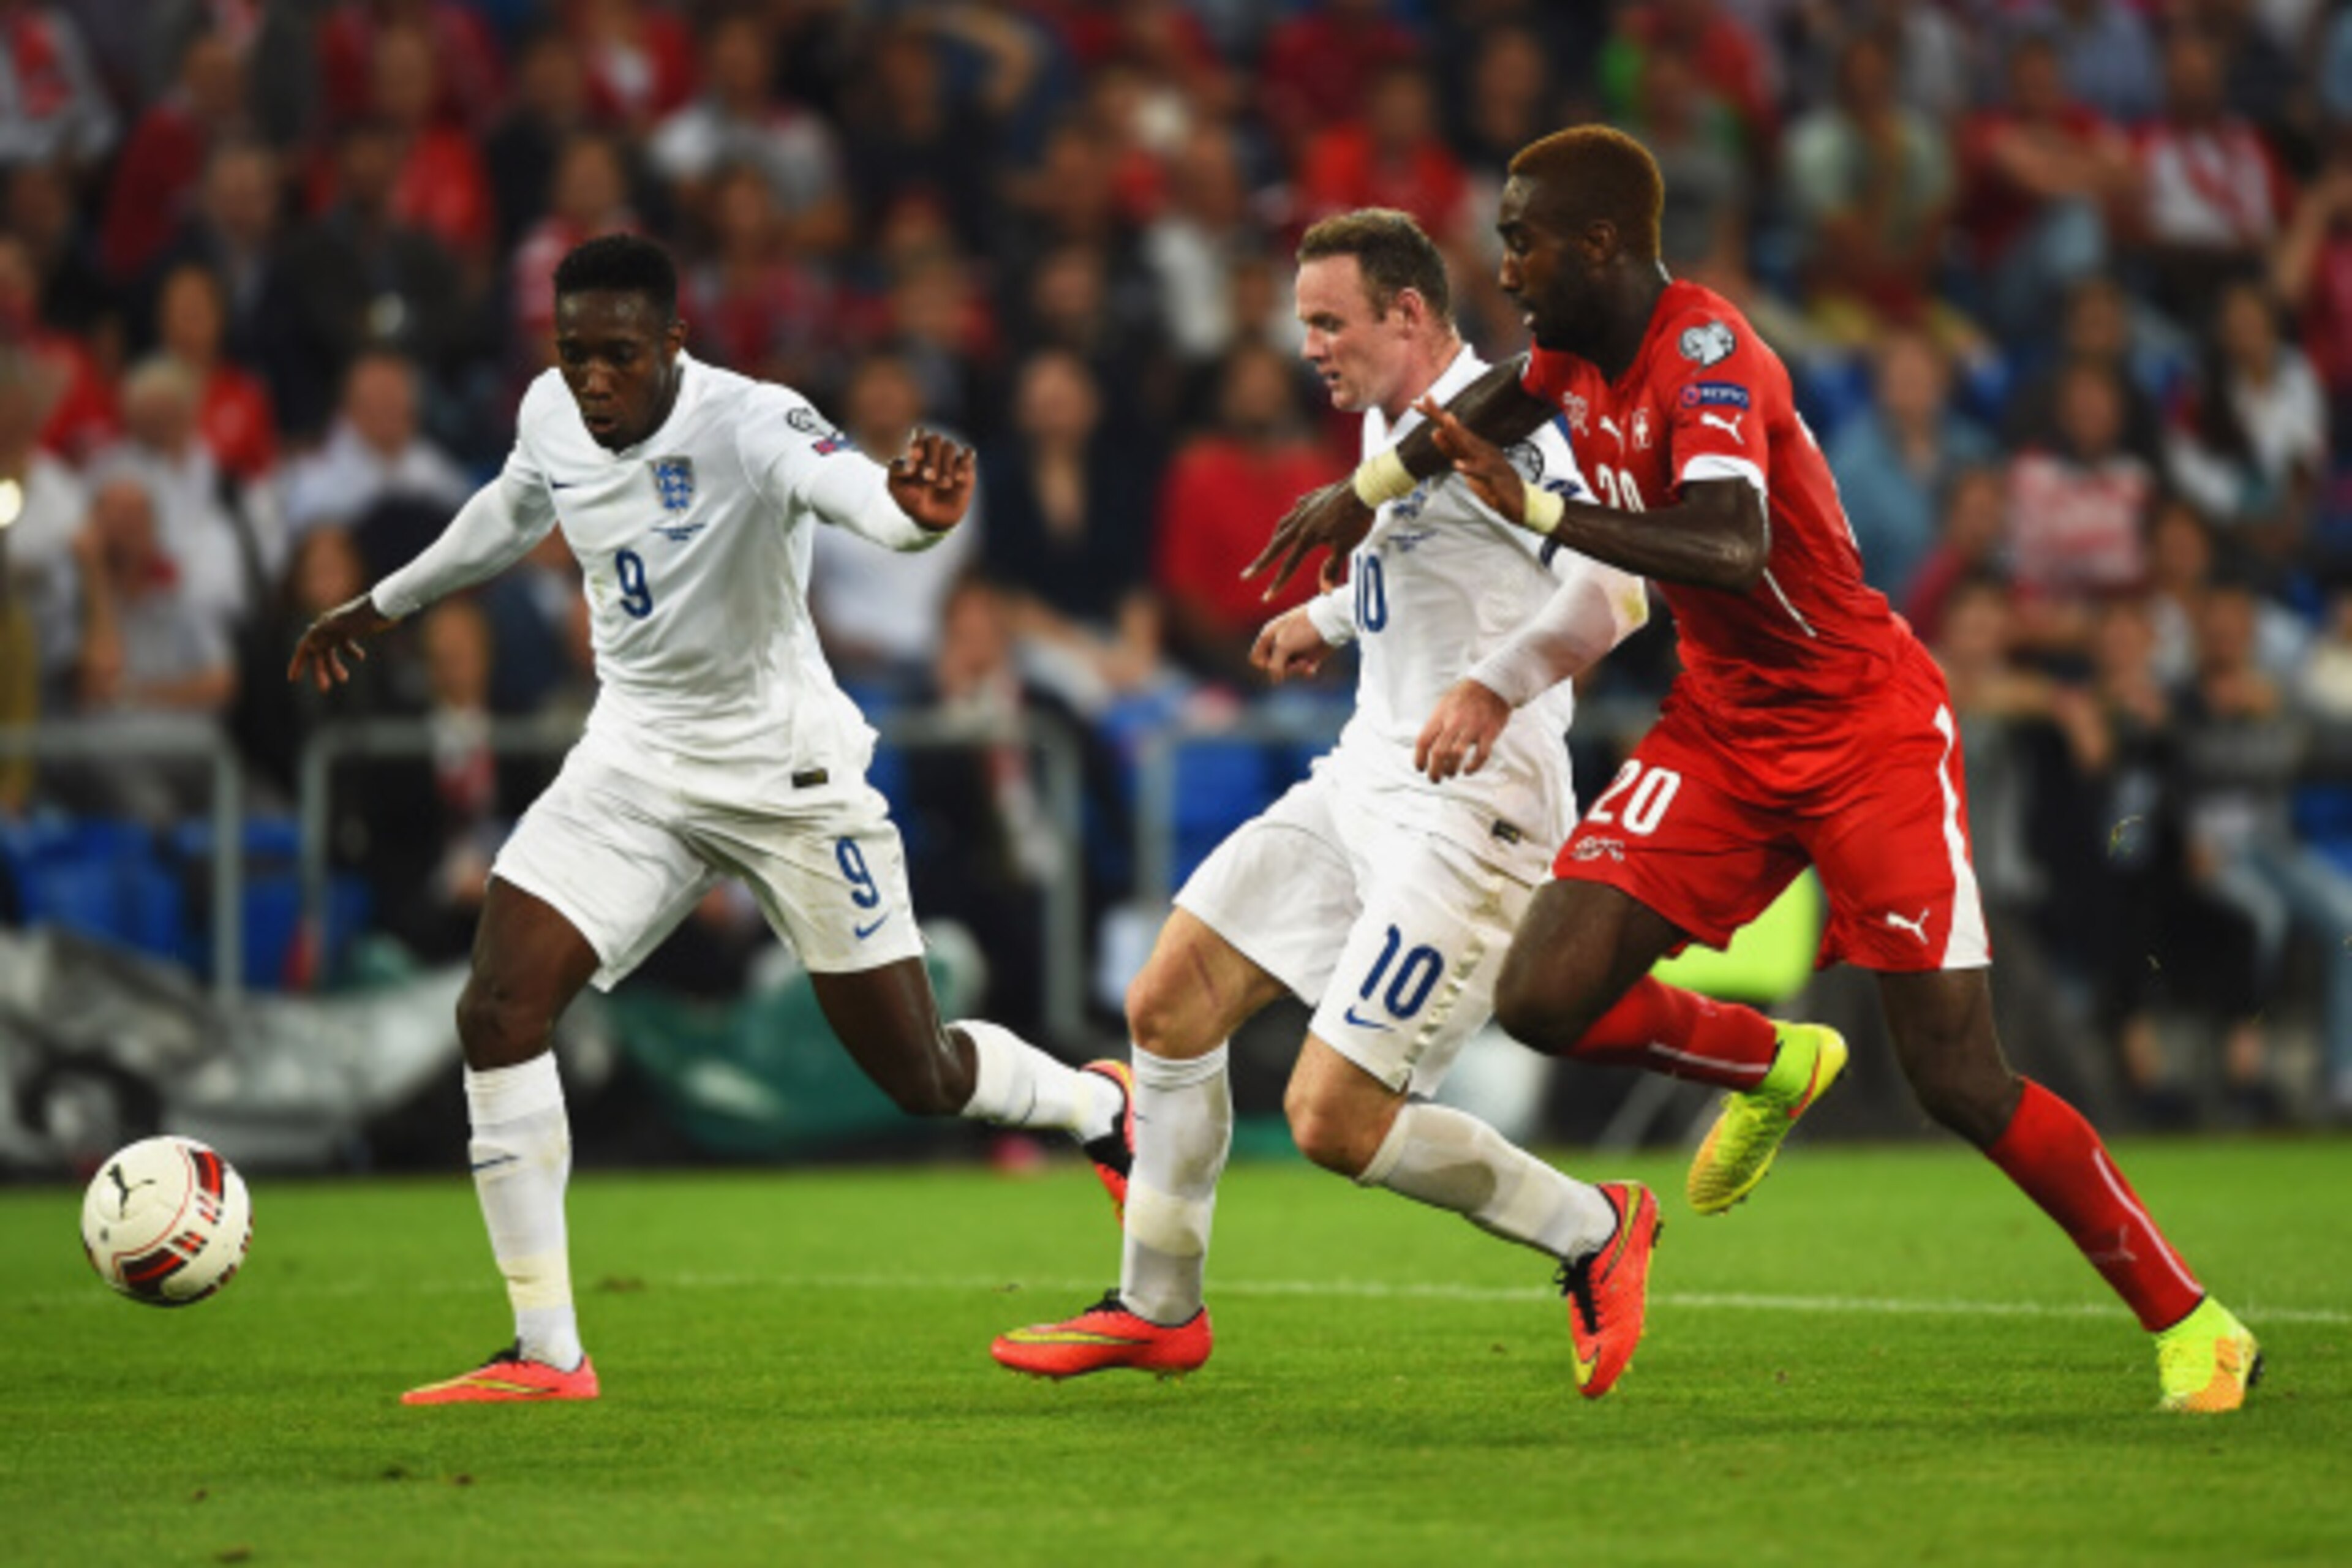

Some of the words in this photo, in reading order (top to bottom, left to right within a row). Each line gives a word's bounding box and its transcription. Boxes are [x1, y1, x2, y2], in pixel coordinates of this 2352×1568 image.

[615, 549, 652, 619] 9
[1355, 554, 1387, 633] 10
[1587, 759, 1680, 835] 20
[836, 835, 880, 908] 9
[1360, 923, 1444, 1020] 10
